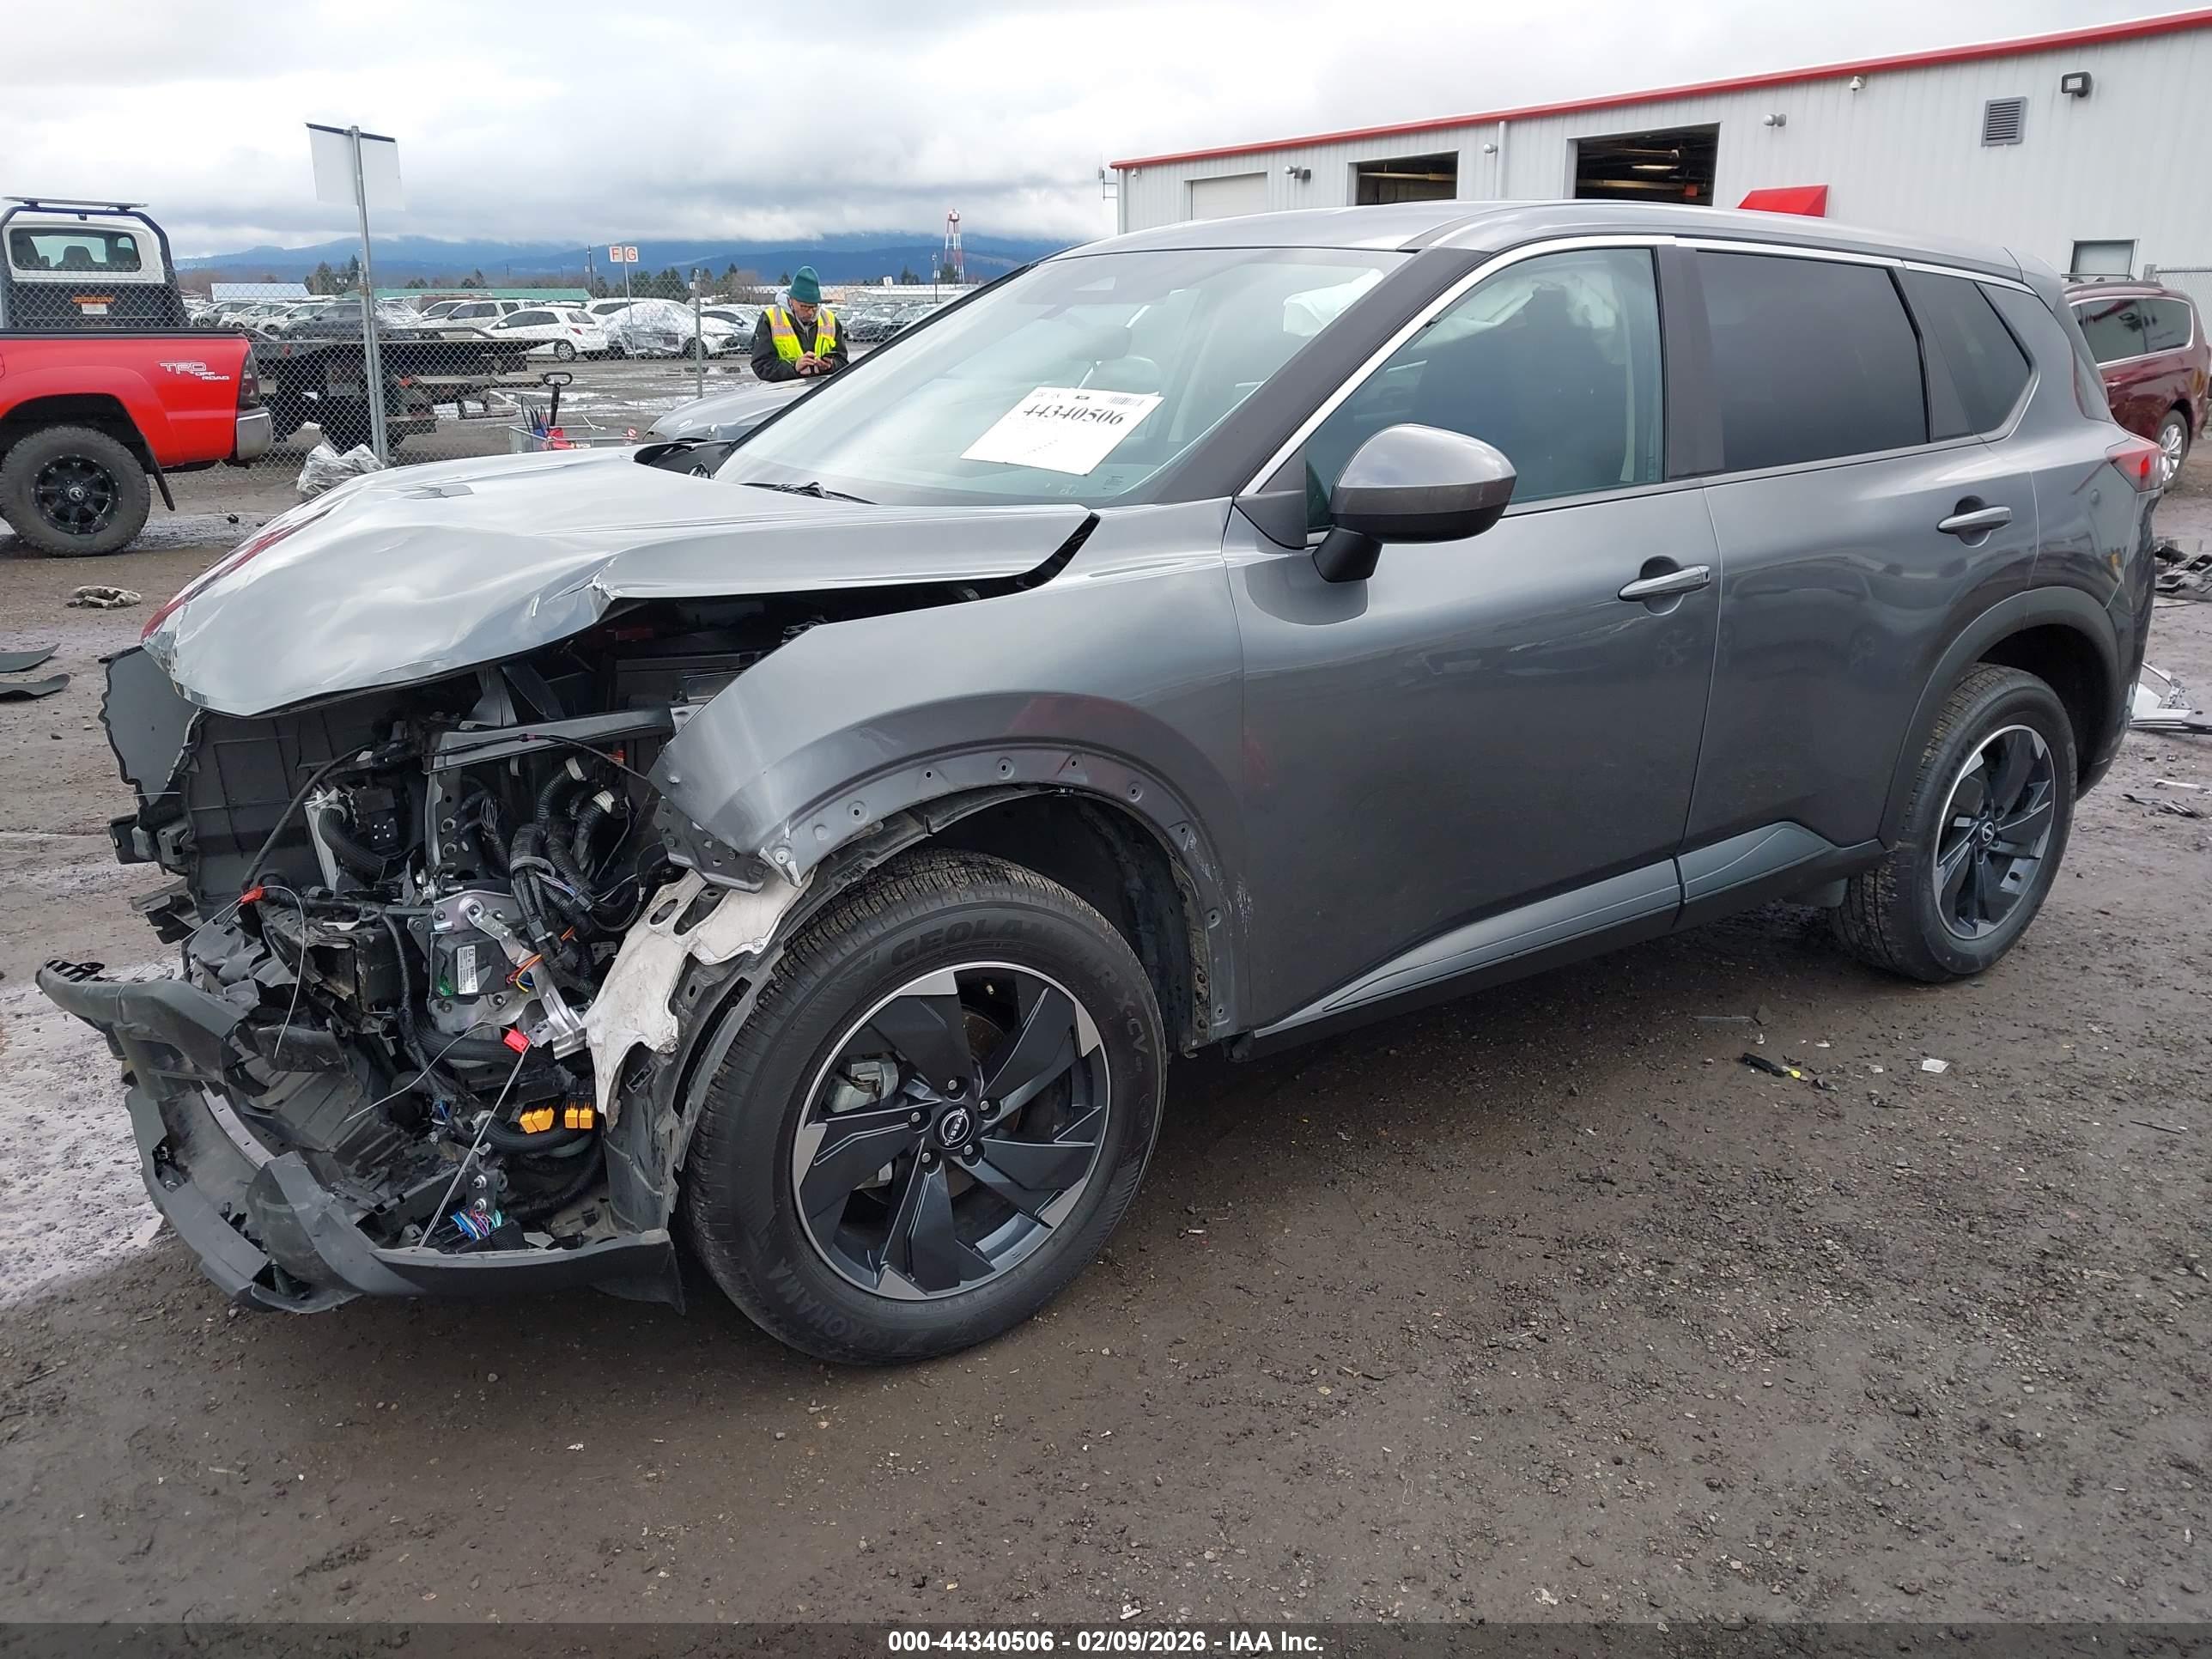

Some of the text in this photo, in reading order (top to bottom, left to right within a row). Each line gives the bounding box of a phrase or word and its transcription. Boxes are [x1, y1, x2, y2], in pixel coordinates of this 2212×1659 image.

[611, 247, 620, 261] F
[626, 247, 637, 261] G
[159, 362, 207, 374] TRD
[1023, 404, 1129, 426] 44340506
[944, 1108, 966, 1146] NISSAN
